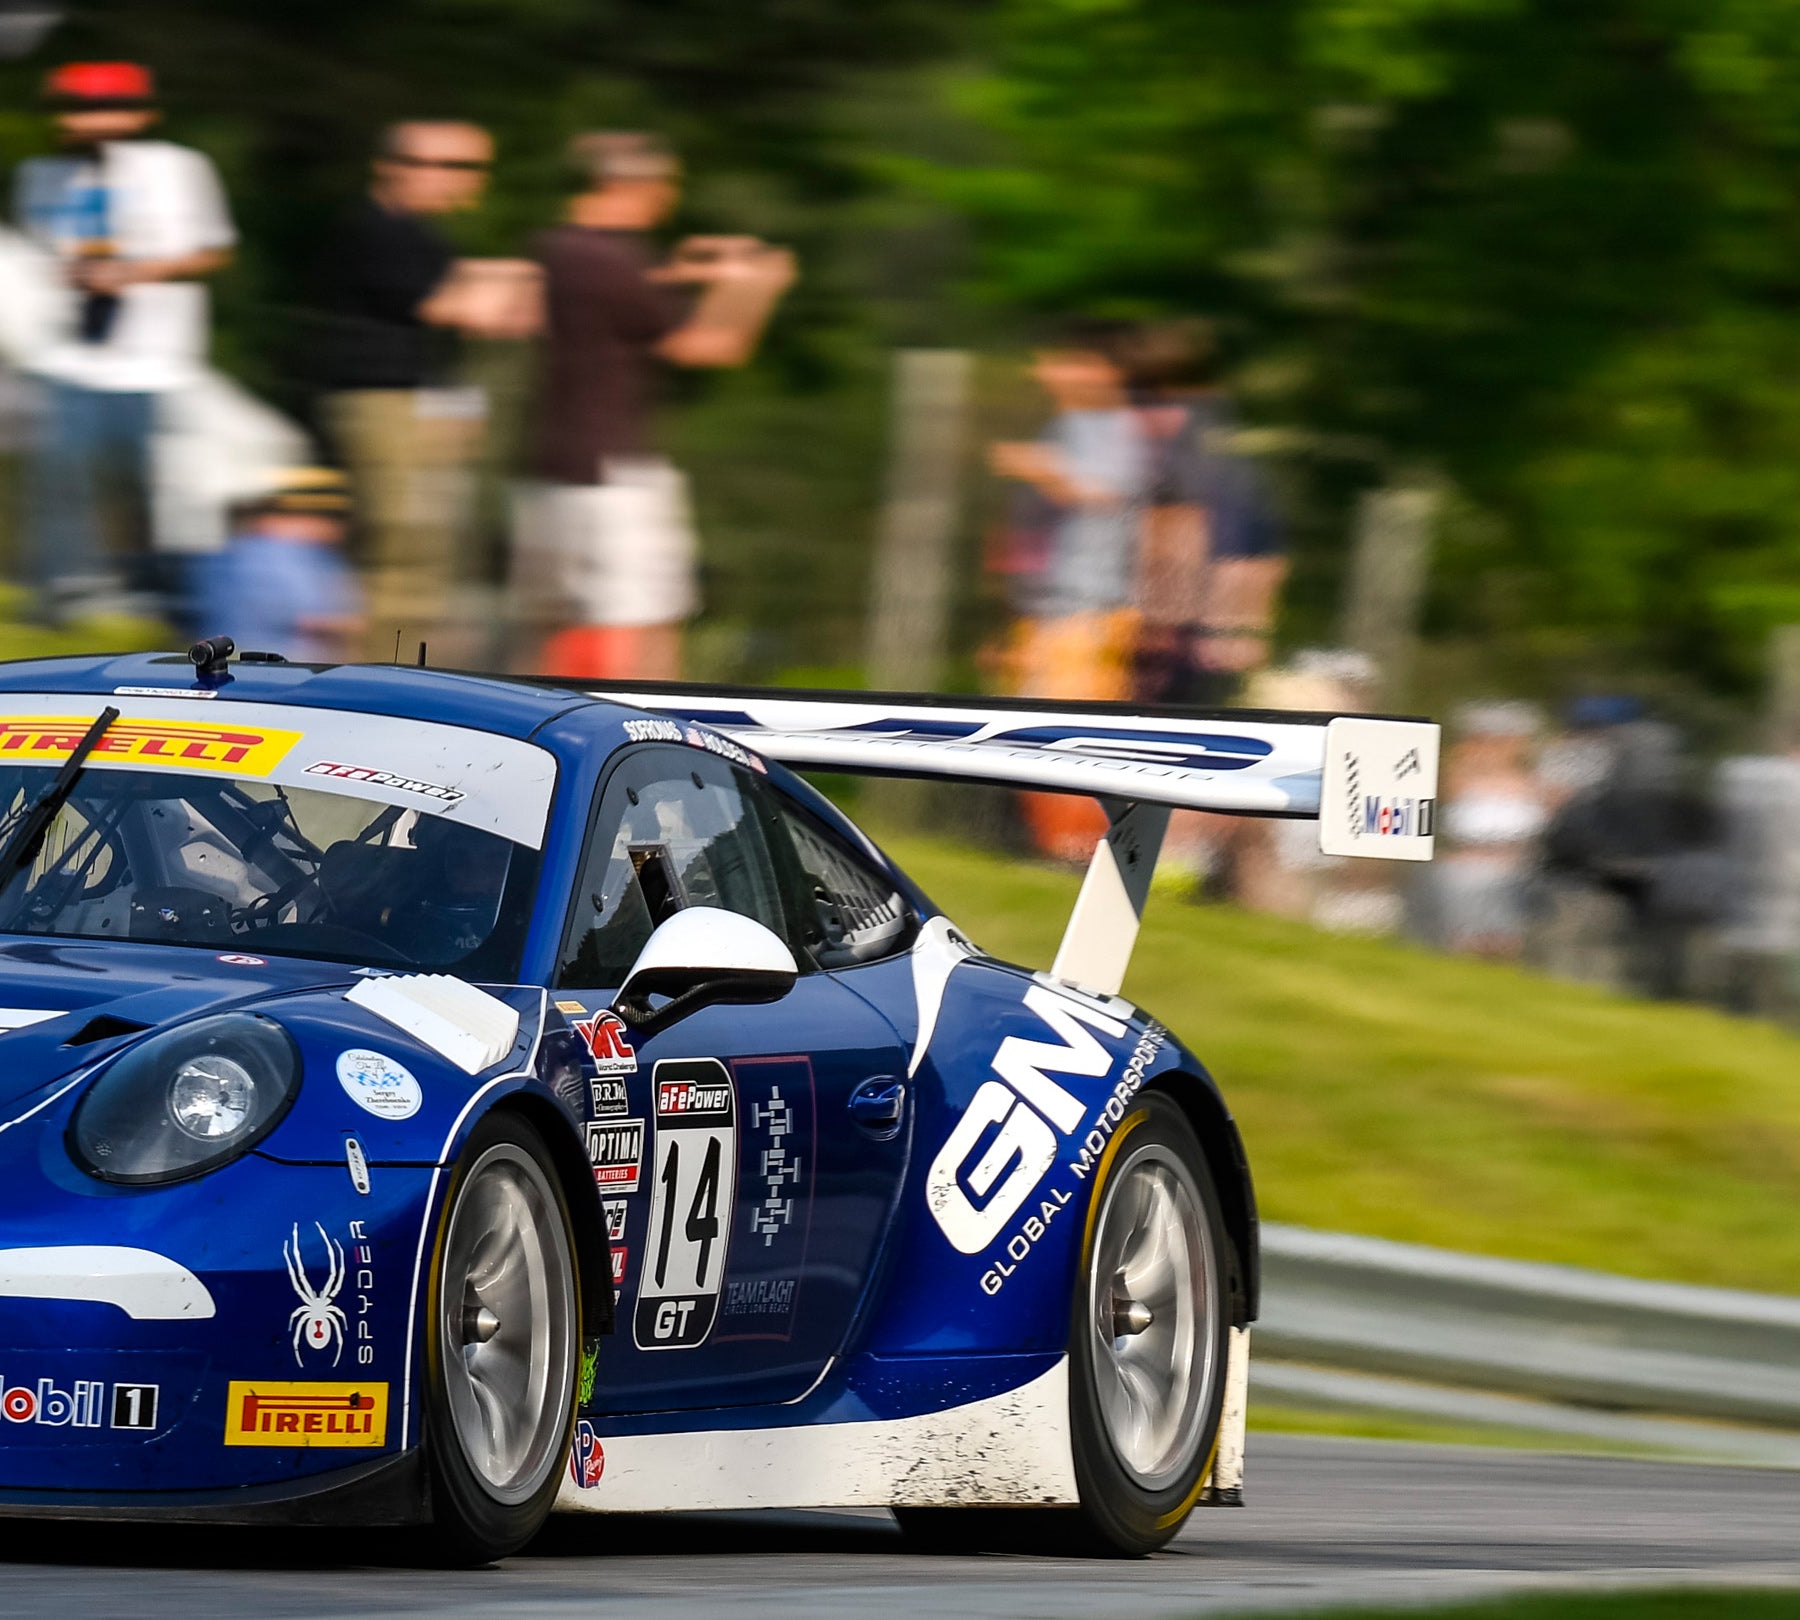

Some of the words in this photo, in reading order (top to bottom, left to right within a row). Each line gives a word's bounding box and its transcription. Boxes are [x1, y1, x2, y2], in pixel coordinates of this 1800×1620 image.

[308, 764, 462, 800] aFePower
[1364, 795, 1416, 837] Mobil
[660, 1086, 729, 1110] aFePower
[591, 1131, 638, 1162] OPTIMA
[597, 1168, 628, 1181] BATTERIES
[655, 1136, 721, 1289] 14
[980, 1188, 1072, 1295] GLOBAL
[349, 1219, 373, 1364] SPYDER
[654, 1301, 696, 1340] GT
[241, 1395, 375, 1434] PIRELLI
